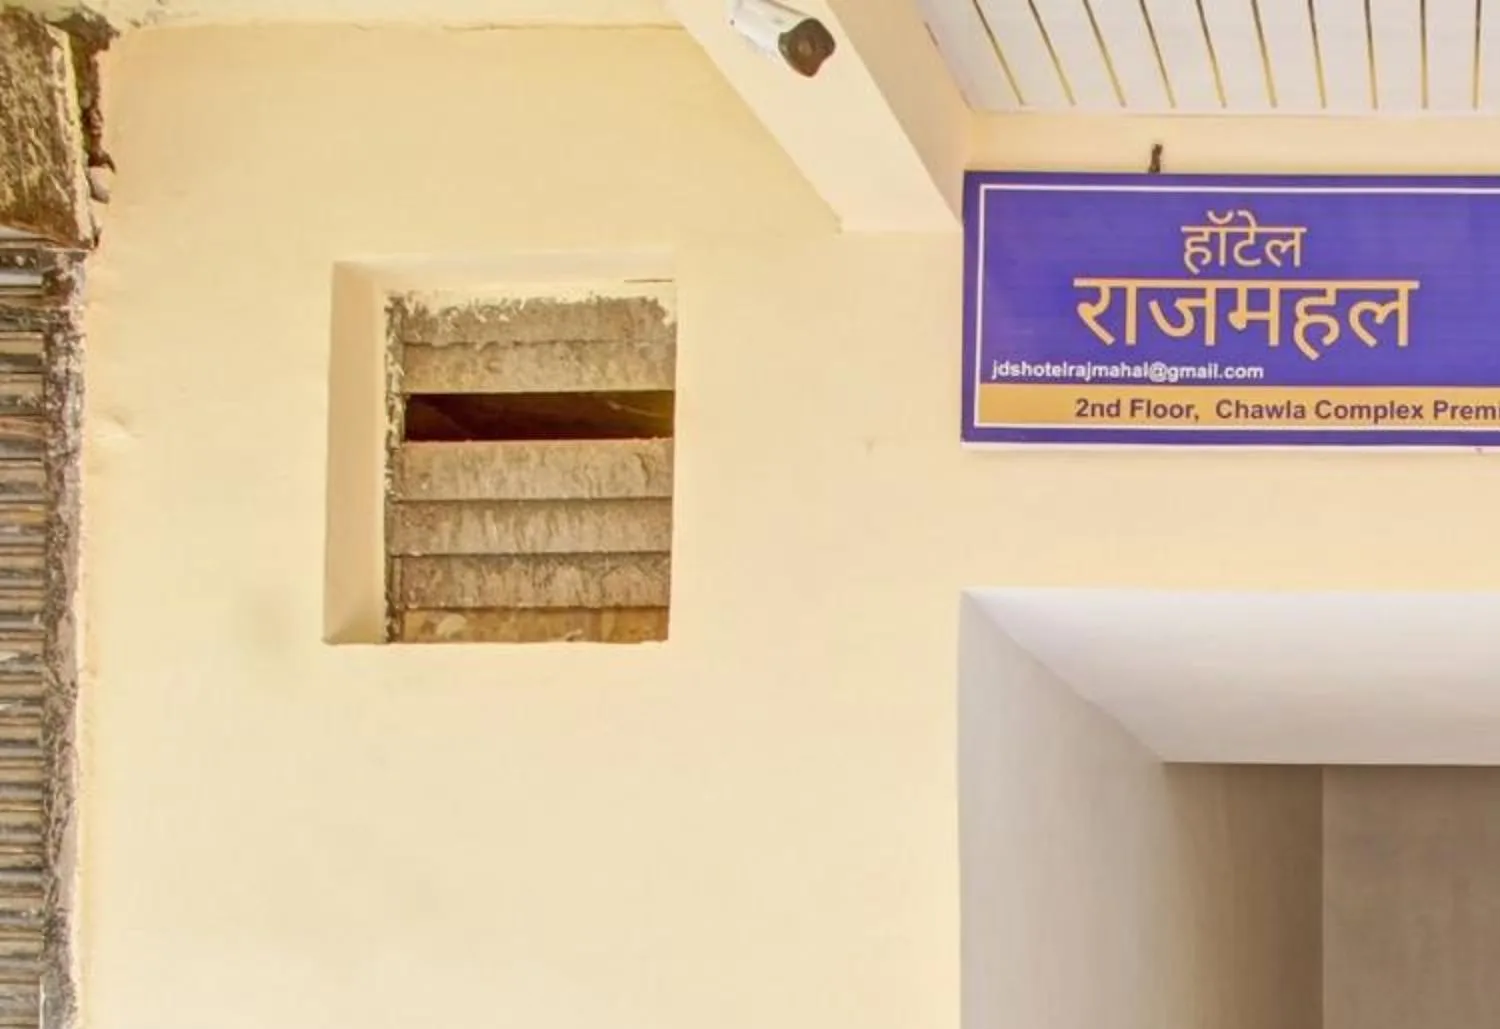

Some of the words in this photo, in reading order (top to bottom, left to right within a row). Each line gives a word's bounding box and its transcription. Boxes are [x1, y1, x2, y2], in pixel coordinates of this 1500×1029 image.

[1181, 209, 1307, 274] हॉटेल
[1073, 277, 1420, 360] राजमहल
[991, 360, 1265, 382] jdshotelrajmahal@gmail.com
[1075, 398, 1121, 418] 2nd
[1129, 399, 1200, 421] Floor,
[1215, 400, 1306, 419] Chawla
[1314, 400, 1424, 424] Complex
